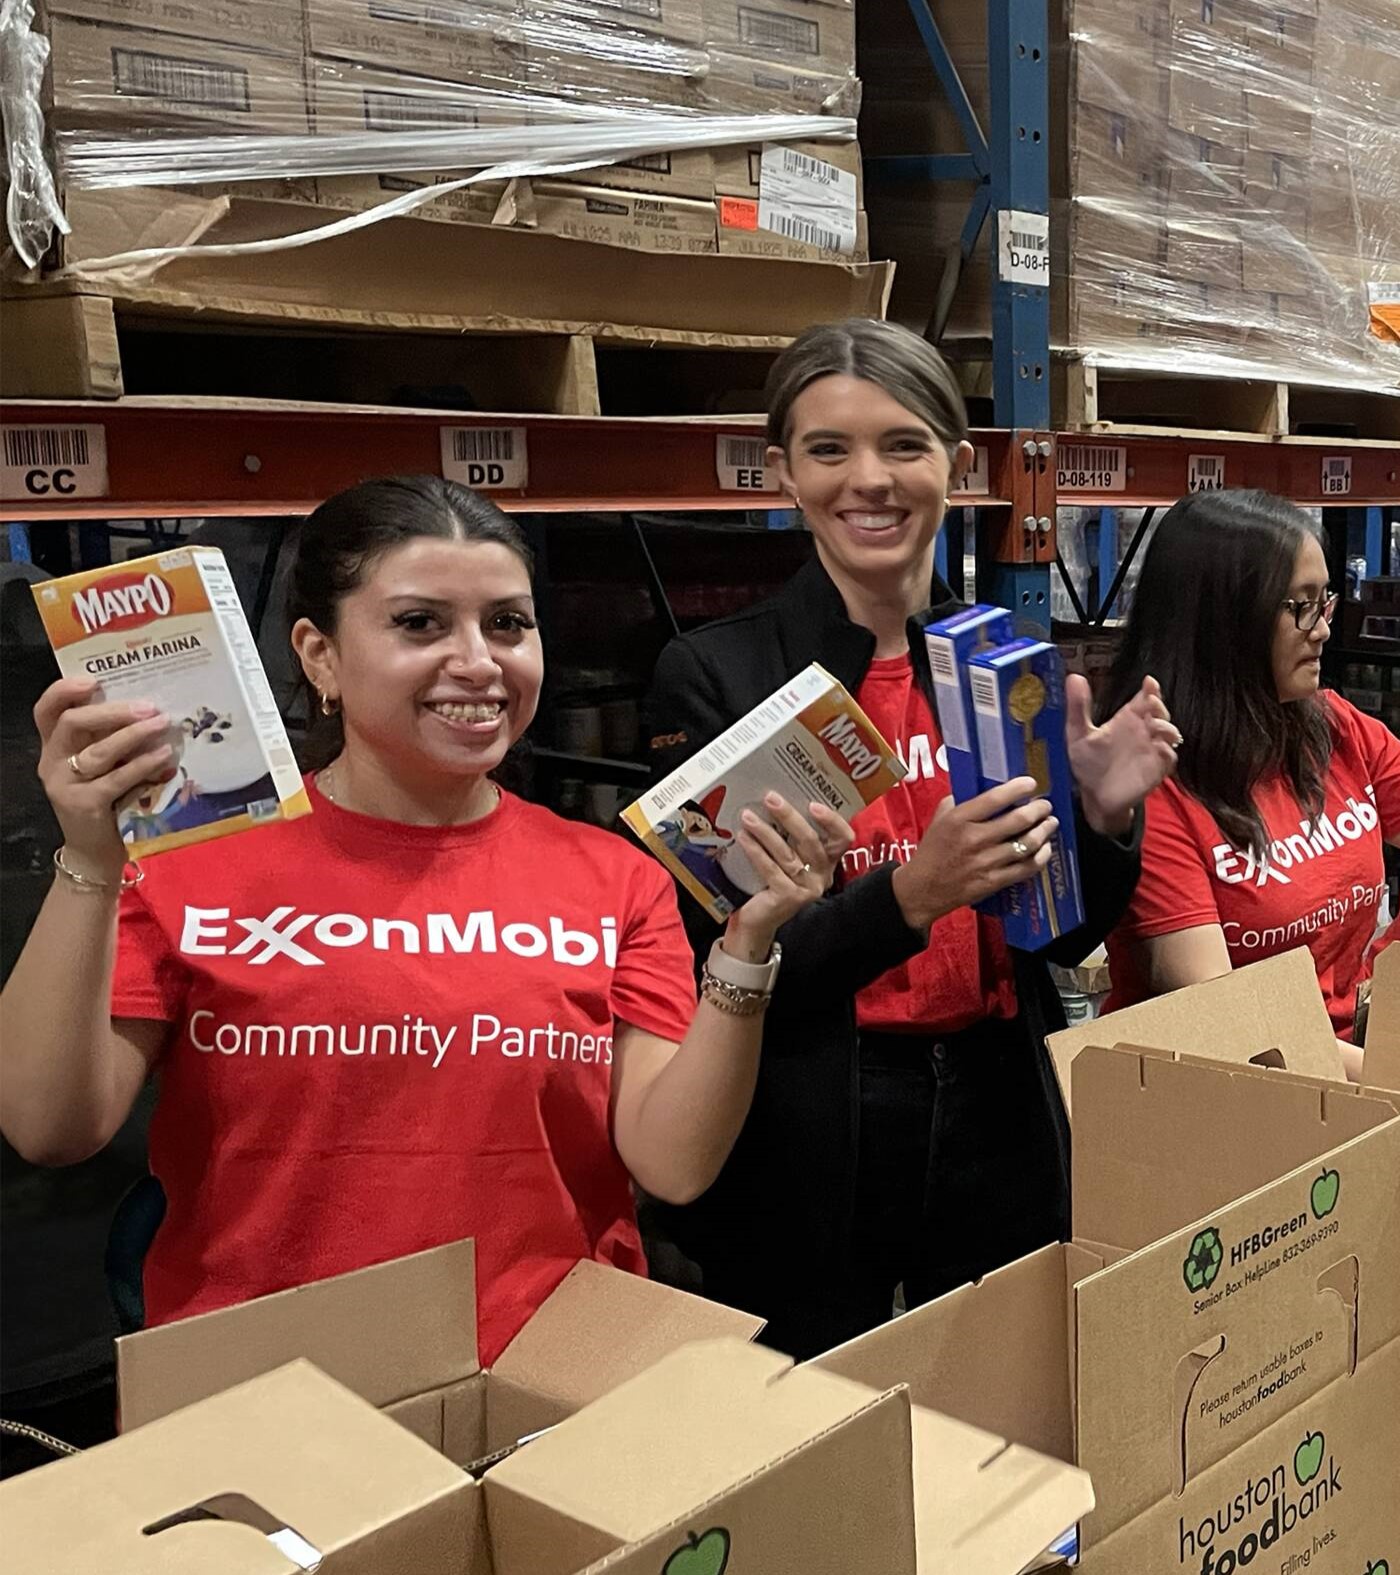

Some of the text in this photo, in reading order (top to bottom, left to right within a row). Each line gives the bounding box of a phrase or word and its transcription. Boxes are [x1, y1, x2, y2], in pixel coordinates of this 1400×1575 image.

[25, 469, 77, 495] CC
[468, 463, 504, 485] DD
[736, 469, 764, 488] EE
[1058, 471, 1112, 487] D-08-119
[1330, 479, 1343, 492] BB
[72, 573, 171, 634] MAYPO
[85, 650, 141, 674] CREAM
[143, 635, 202, 660] FARINA
[817, 712, 882, 780] MAYPO
[785, 741, 816, 775] CREAM
[812, 774, 844, 811] FARINA
[1223, 897, 1349, 949] Community
[189, 1009, 614, 1068] Community Partners
[1231, 1213, 1308, 1266] HFBGreen
[1193, 1290, 1223, 1315] Senior
[1225, 1281, 1243, 1297] Box
[1244, 1259, 1281, 1287] HelpLine
[1200, 1330, 1324, 1418] Please return usable boxes to
[1219, 1359, 1308, 1429] houstonfoodbank
[1179, 1464, 1286, 1564] houston
[1200, 1455, 1344, 1575] foodbank
[1280, 1547, 1311, 1575] Filling
